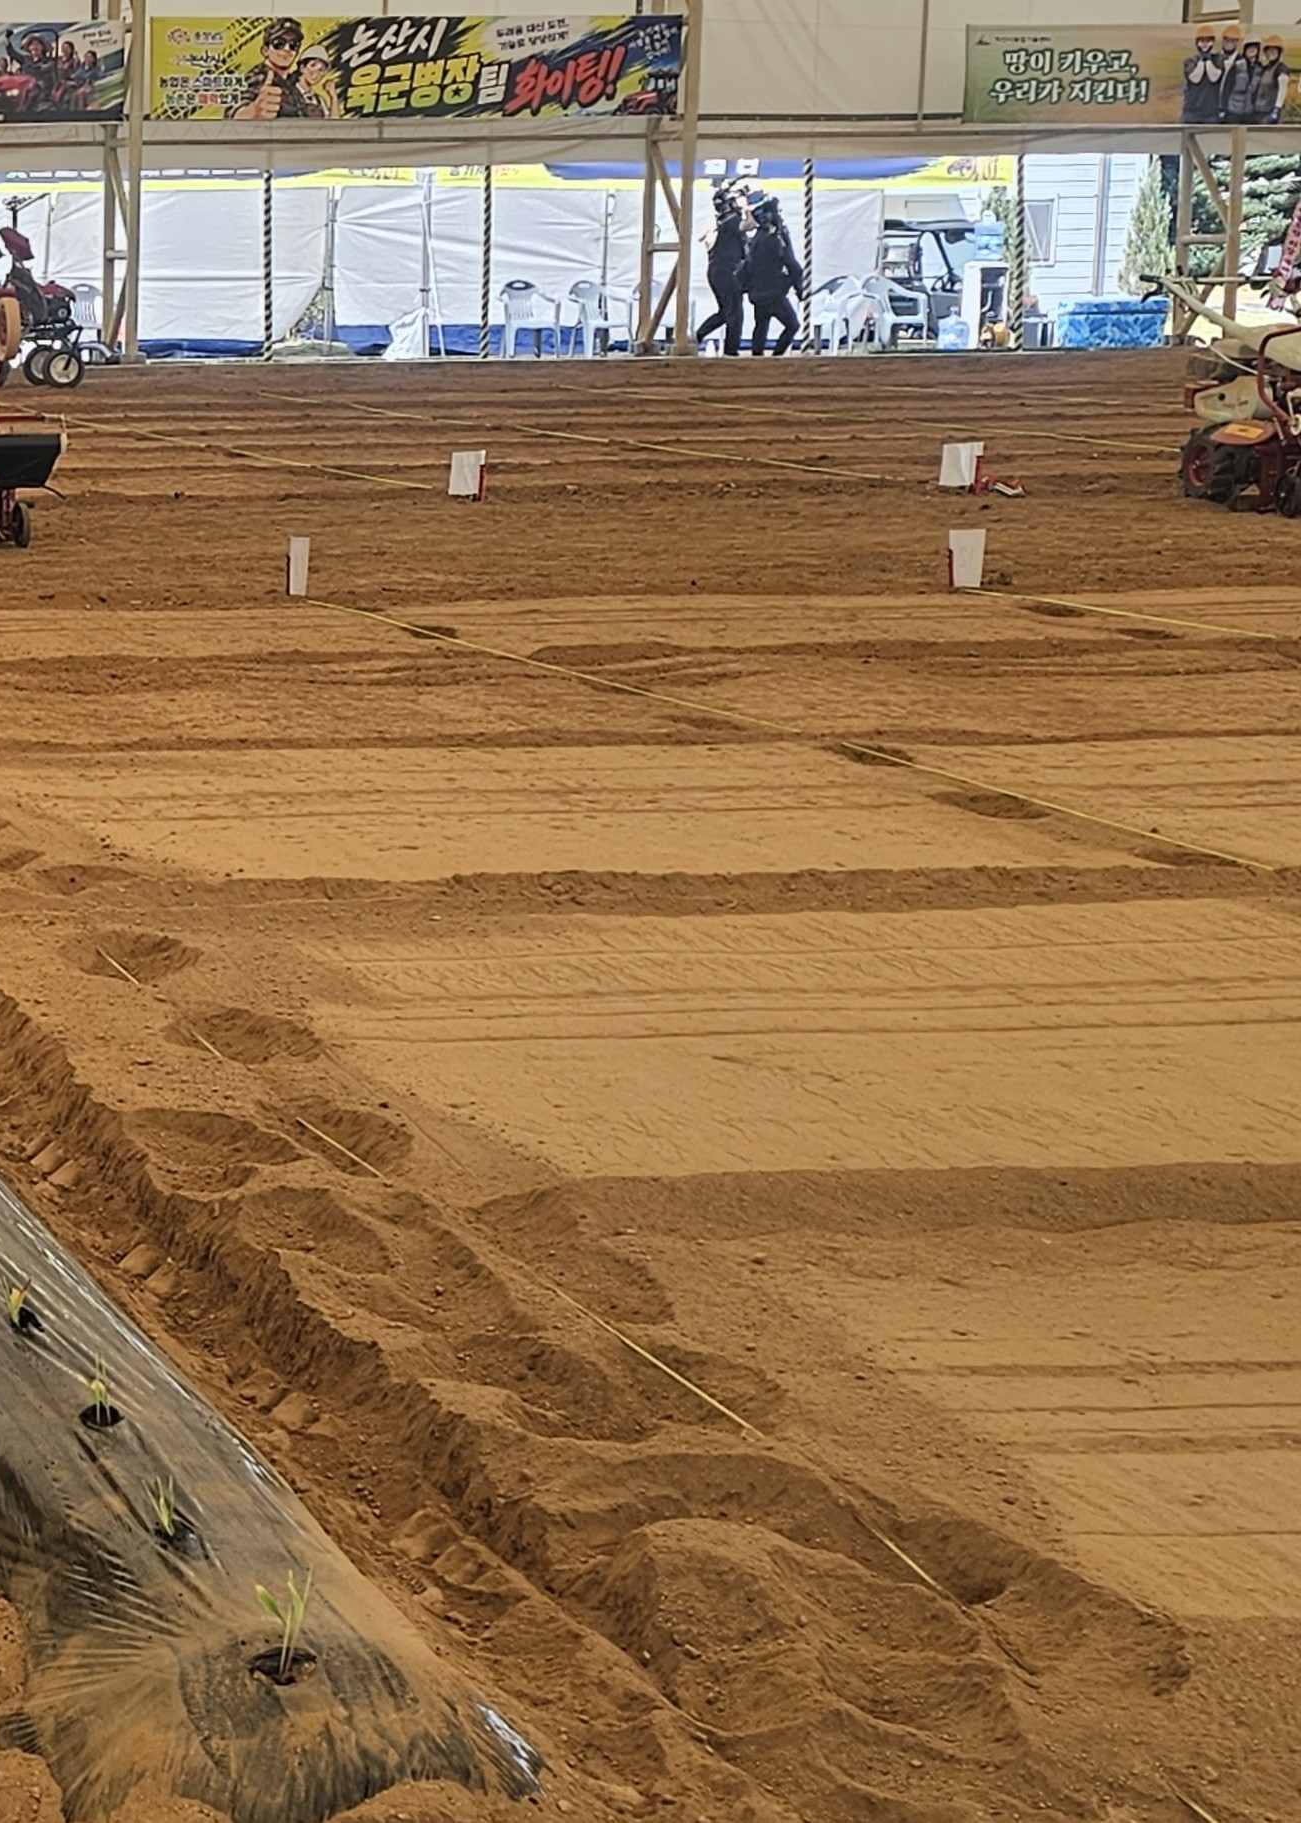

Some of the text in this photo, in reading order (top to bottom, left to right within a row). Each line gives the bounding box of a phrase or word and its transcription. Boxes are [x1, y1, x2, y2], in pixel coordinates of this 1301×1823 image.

[341, 17, 448, 67] 논산시
[1003, 50, 1137, 75] 땅이 키우고,
[989, 79, 1148, 104] 우리가 지킨다!
